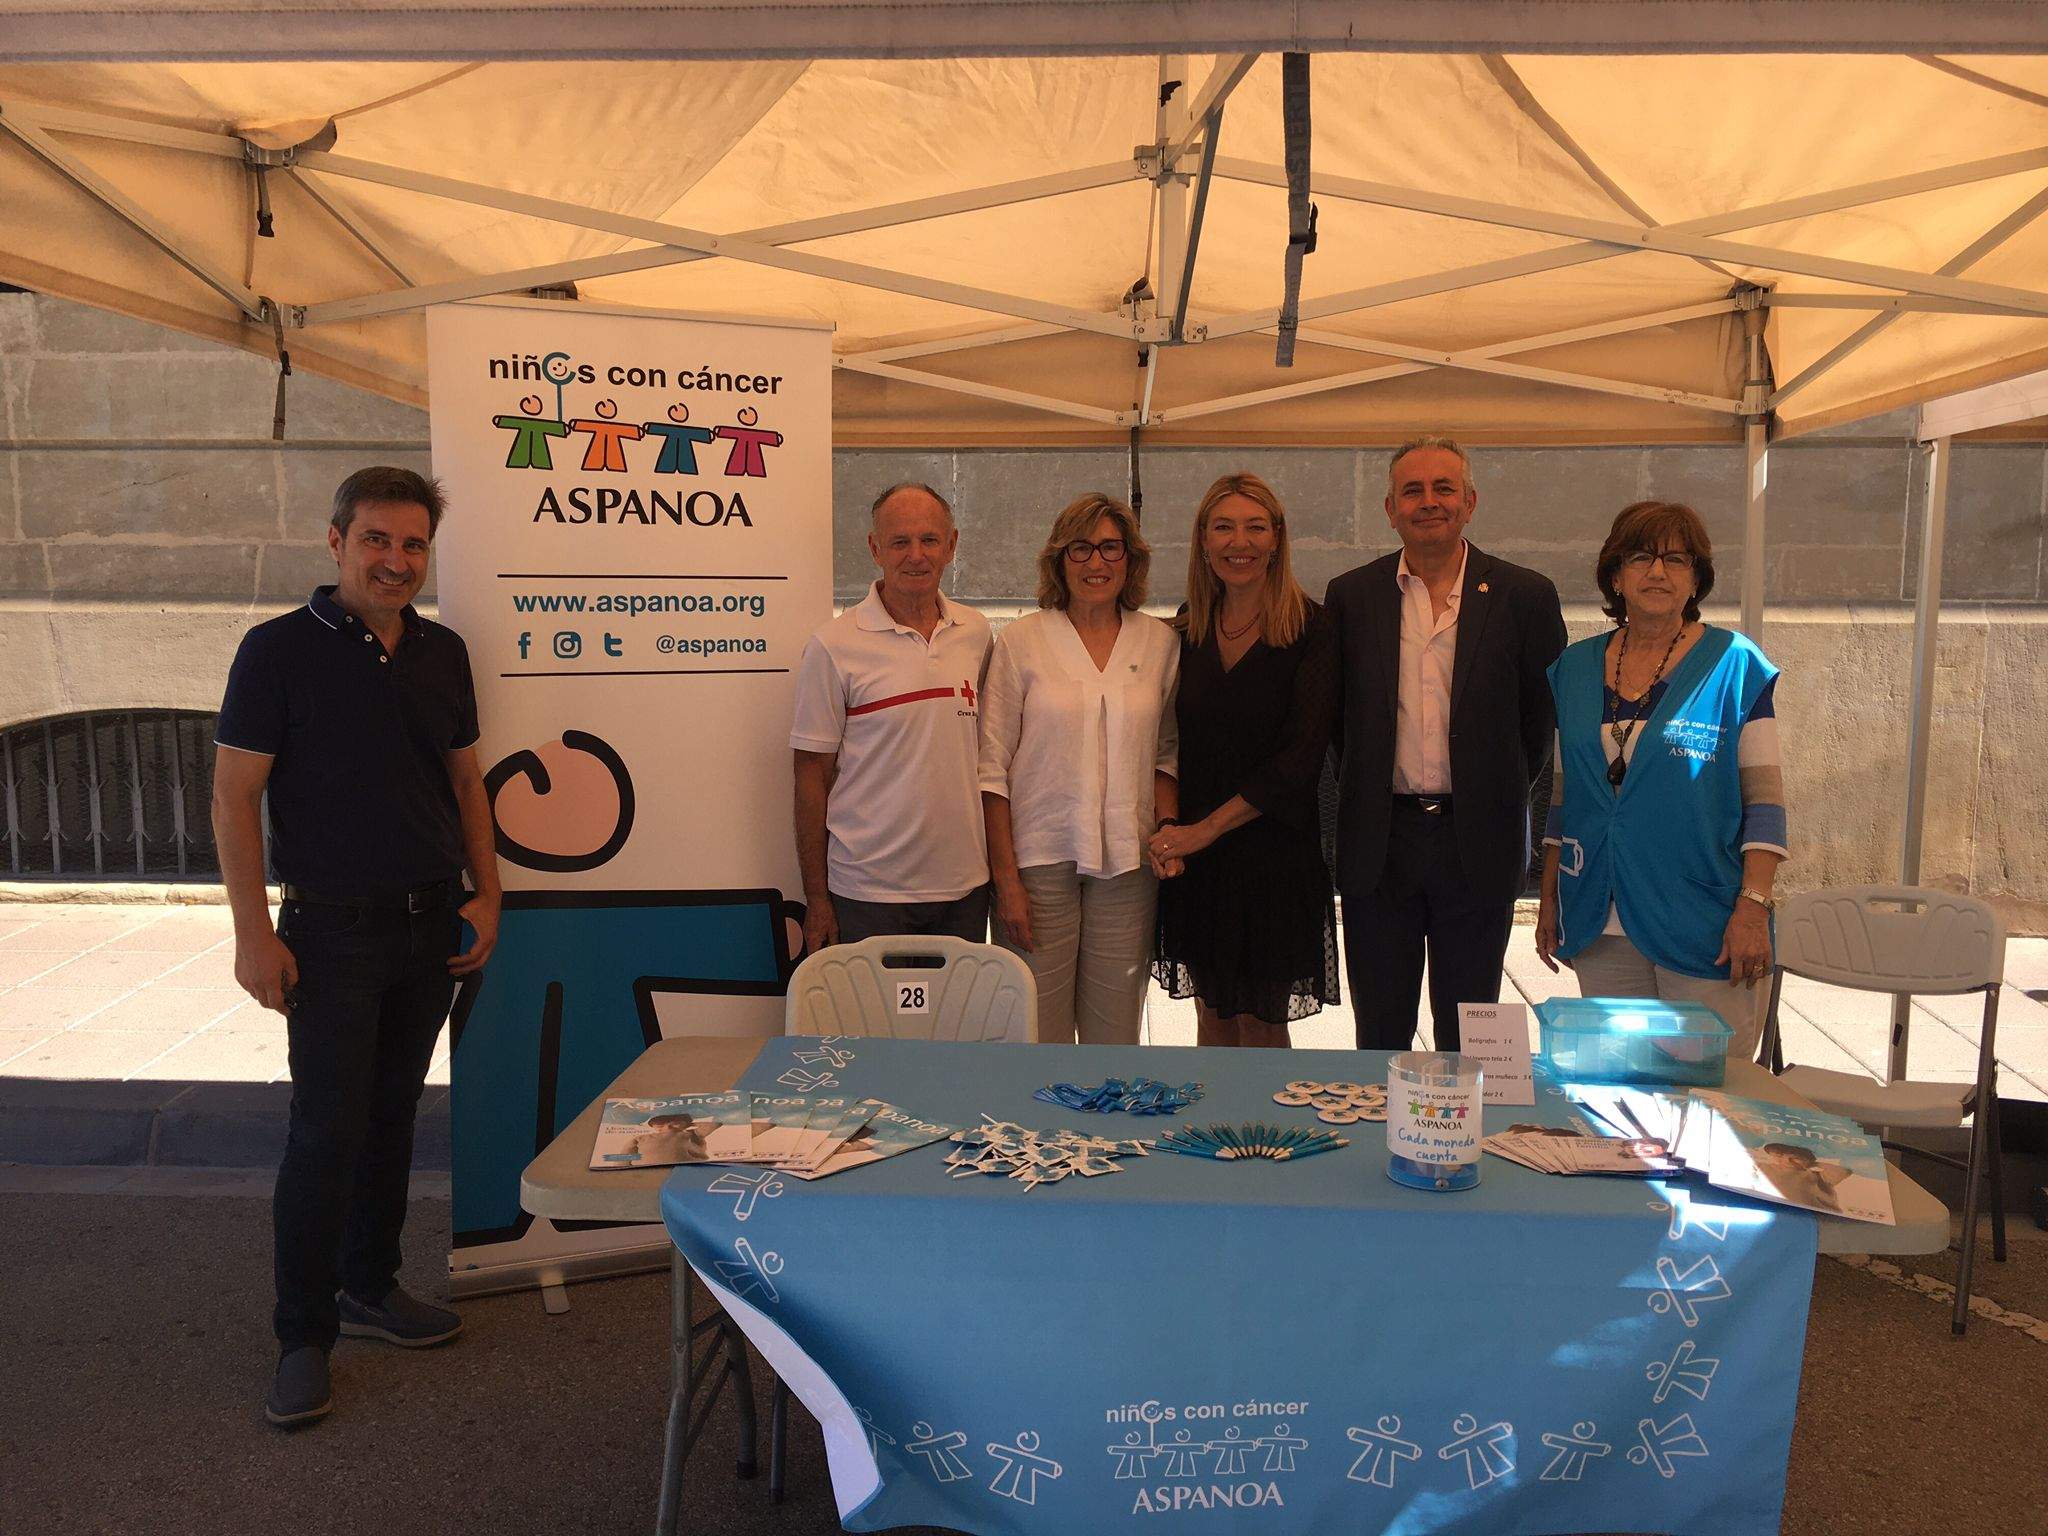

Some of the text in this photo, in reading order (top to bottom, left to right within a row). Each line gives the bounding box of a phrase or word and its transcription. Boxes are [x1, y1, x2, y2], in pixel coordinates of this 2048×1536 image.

[607, 364, 667, 389] con
[677, 365, 783, 395] cáncer
[533, 487, 753, 527] ASPANOA
[512, 592, 766, 617] www.aspanoa.org
[656, 634, 767, 657] @aspanoa
[1691, 721, 1706, 729] con
[1668, 747, 1717, 763] ASPANOA
[900, 987, 925, 1008] 28
[1466, 1010, 1497, 1018] PRECIOS
[612, 1095, 739, 1111] Aspanoa
[1413, 1118, 1463, 1131] ASPANOA
[1398, 1127, 1476, 1148] Cada moneda
[1415, 1149, 1458, 1162] cuenta
[1184, 1404, 1225, 1420] con
[1232, 1399, 1310, 1418] cáncer
[1132, 1481, 1285, 1515] ASPANOA
